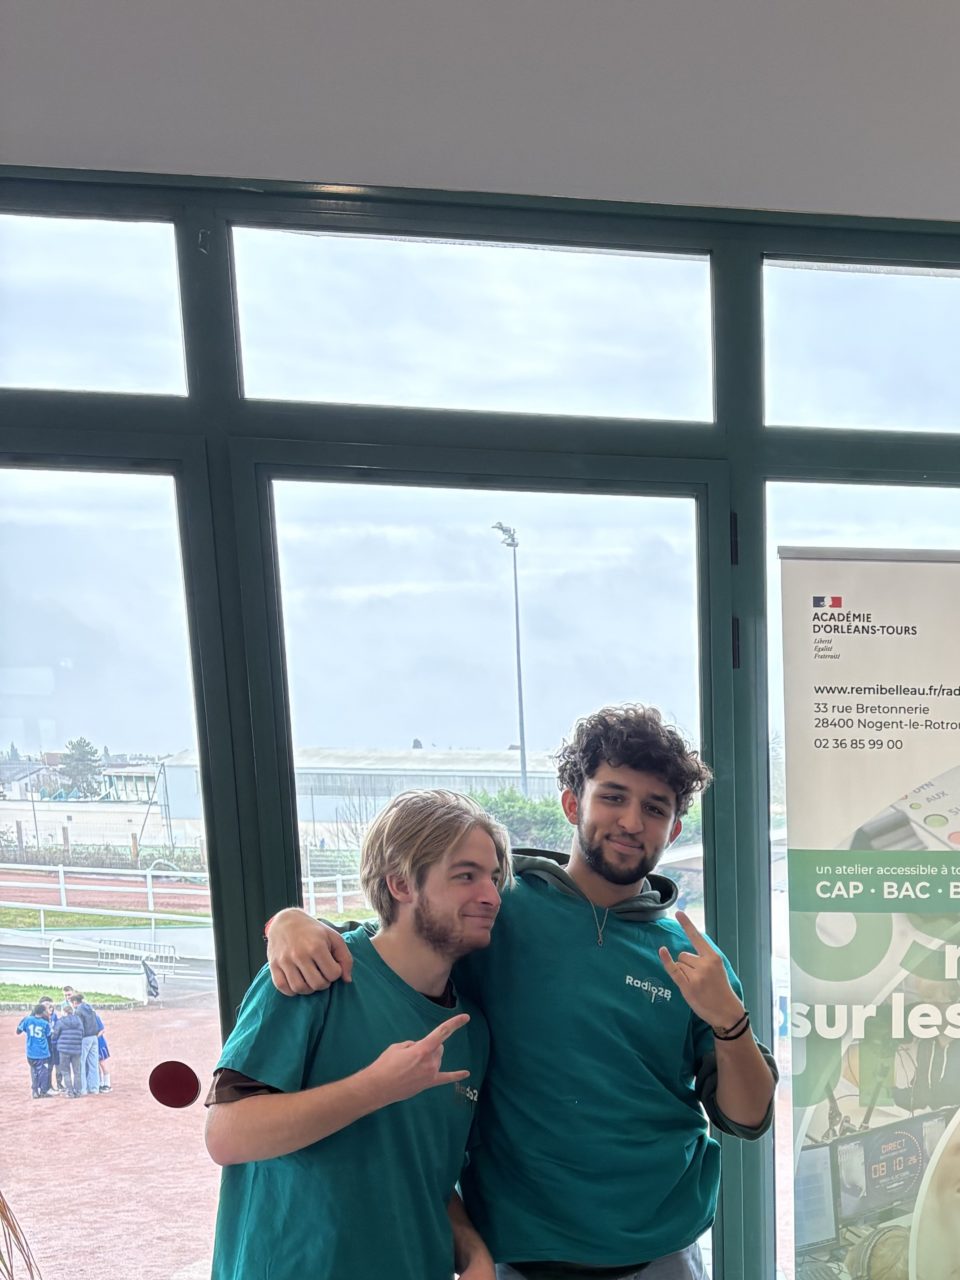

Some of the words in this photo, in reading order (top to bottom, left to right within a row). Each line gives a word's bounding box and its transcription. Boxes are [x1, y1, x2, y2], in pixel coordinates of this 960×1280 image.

[812, 610, 872, 622] ACADÉMIE
[812, 623, 917, 636] D'ORLÉANS-TOURS
[814, 703, 828, 714] 33
[832, 705, 852, 714] rue
[856, 704, 930, 714] Bretonnerie
[814, 718, 854, 728] 28400
[814, 738, 830, 748] 02
[832, 738, 848, 749] 36
[850, 739, 866, 750] 85
[868, 739, 884, 750] 99
[886, 740, 903, 750] 00
[816, 866, 832, 874] un
[835, 864, 874, 874] atelier
[876, 864, 938, 875] accessible
[940, 864, 948, 875] à
[816, 880, 864, 899] CAP
[883, 882, 930, 899] BAC
[626, 975, 672, 1000] Radio2B
[791, 1002, 877, 1040] sur
[28, 1024, 43, 1038] 15
[881, 1139, 906, 1154] DIRECT
